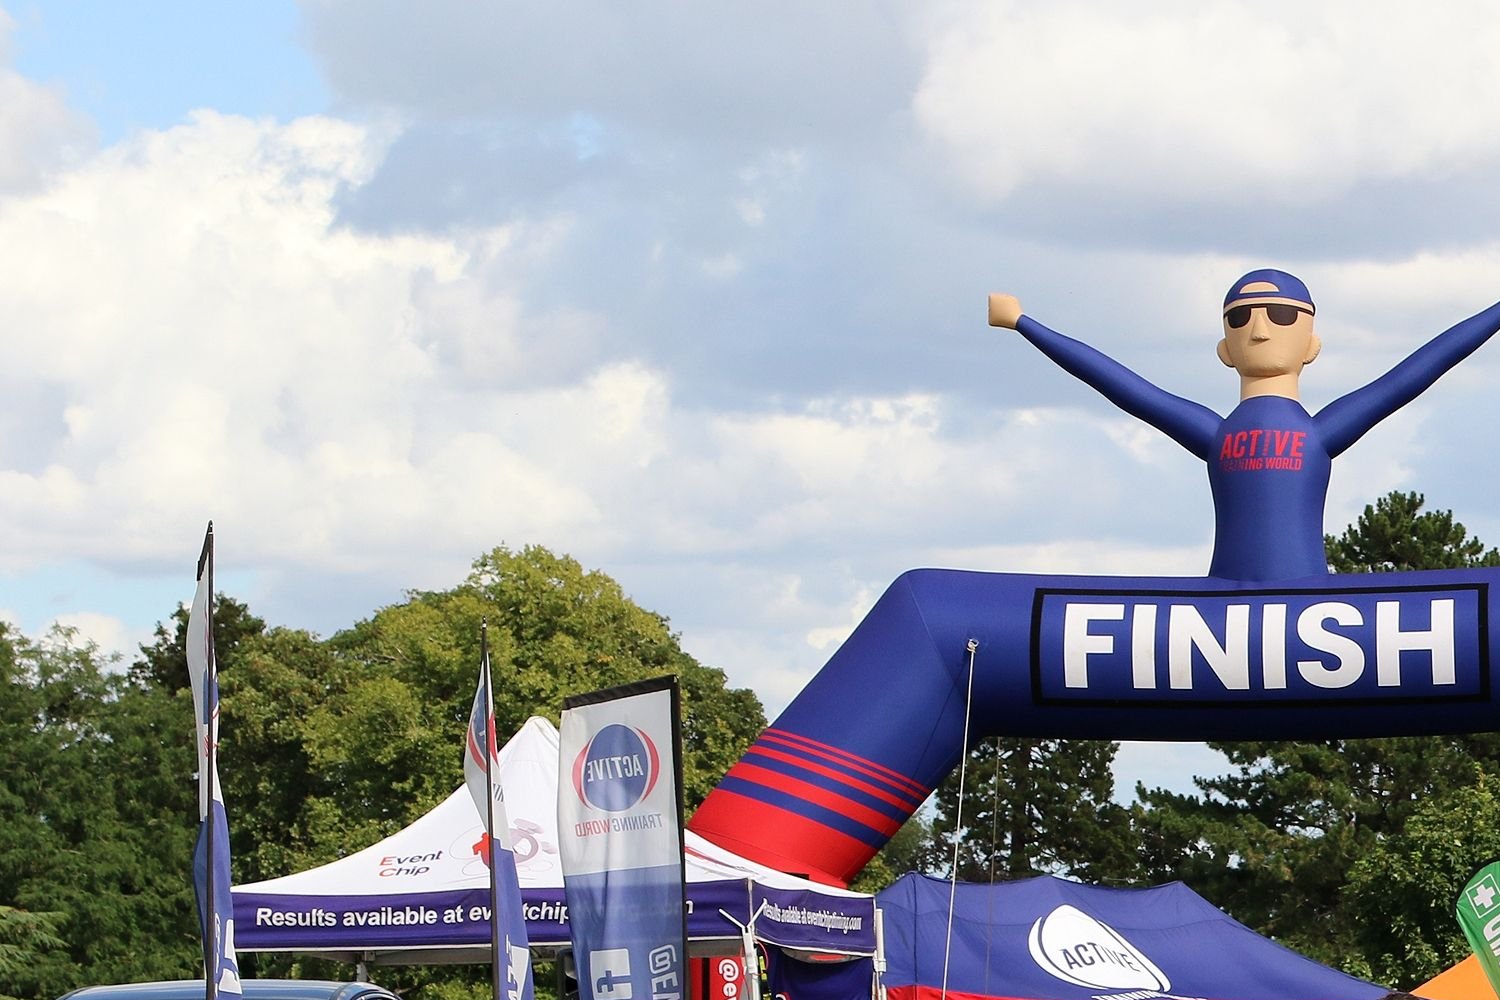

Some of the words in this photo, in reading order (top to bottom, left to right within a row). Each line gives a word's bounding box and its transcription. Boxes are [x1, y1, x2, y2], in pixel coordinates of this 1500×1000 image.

[1220, 430, 1306, 460] ACTIVE
[1265, 457, 1302, 471] WORLD
[1062, 598, 1457, 691] FINISH
[379, 850, 443, 867] Event
[379, 865, 430, 877] Chip
[256, 908, 338, 928] Results
[343, 906, 437, 926] available
[443, 904, 463, 923] at
[1058, 942, 1141, 973] ACTIVE
